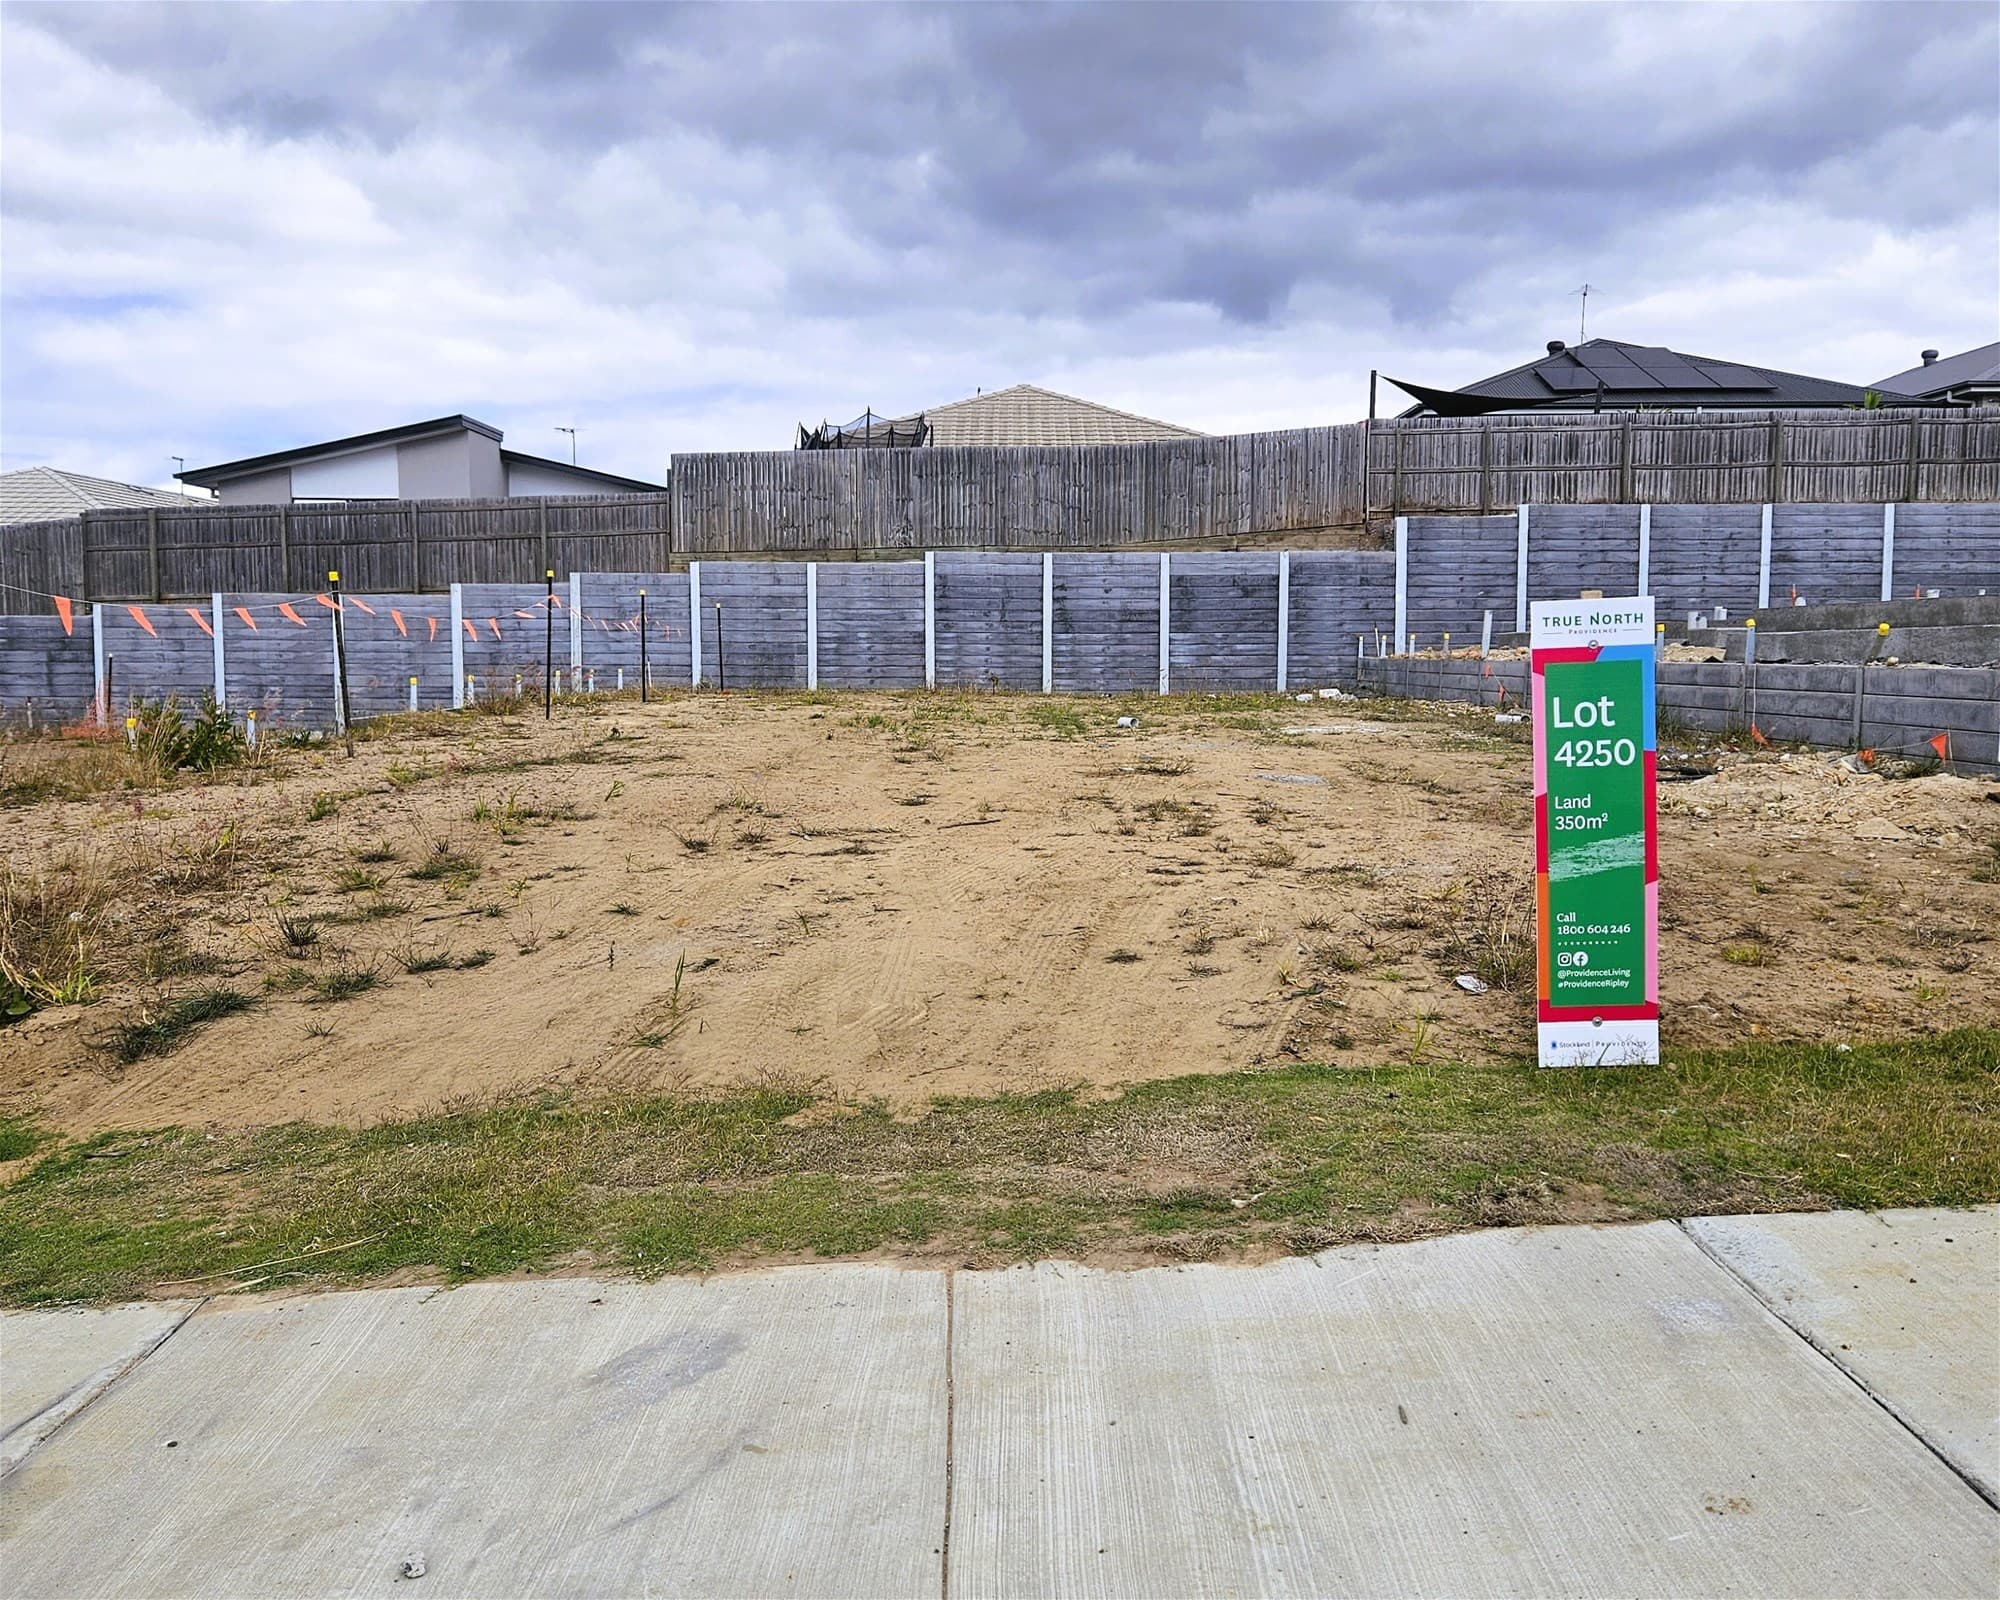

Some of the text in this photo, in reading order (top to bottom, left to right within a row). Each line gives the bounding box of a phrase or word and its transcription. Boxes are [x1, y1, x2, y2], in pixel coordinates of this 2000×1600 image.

[1542, 611, 1644, 627] TRUE NORTH
[1553, 696, 1615, 728] Lot
[1553, 738, 1636, 767] 4250
[1554, 794, 1592, 809] Land
[1556, 912, 1577, 923] Call
[1557, 924, 1631, 935] 1800 604 246
[1557, 968, 1631, 979] @ProvidenceLiving
[1557, 979, 1629, 989] #ProvidenceRipley
